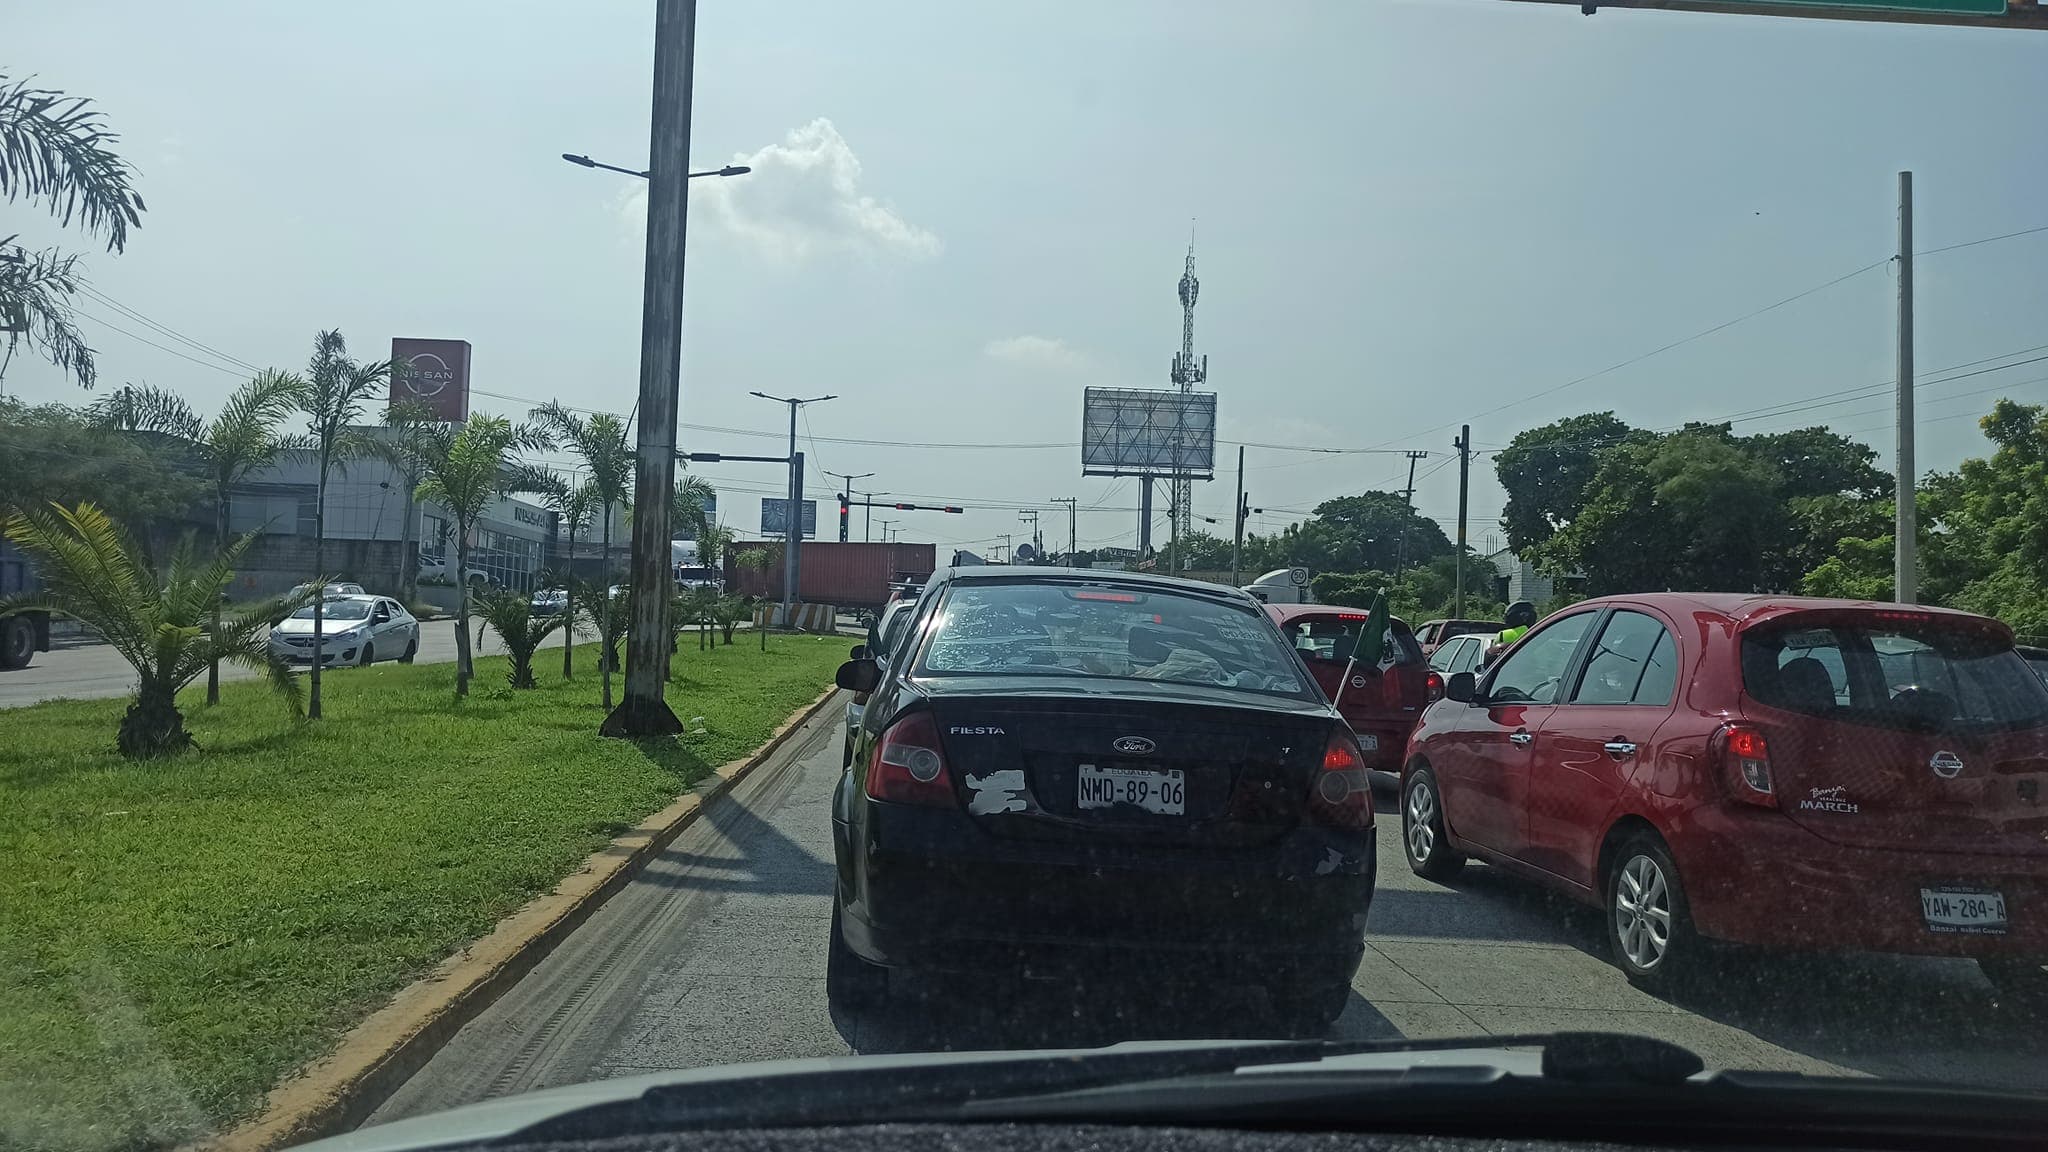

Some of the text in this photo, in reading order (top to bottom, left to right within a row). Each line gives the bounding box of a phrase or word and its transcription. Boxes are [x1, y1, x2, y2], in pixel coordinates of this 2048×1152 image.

[1294, 571, 1305, 580] 50
[950, 726, 1005, 735] FIESTA
[1124, 740, 1147, 750] Ford
[1081, 777, 1183, 805] NMD-89-06
[1800, 800, 1859, 813] MARCH
[1923, 897, 2006, 920] YAW-284-A
